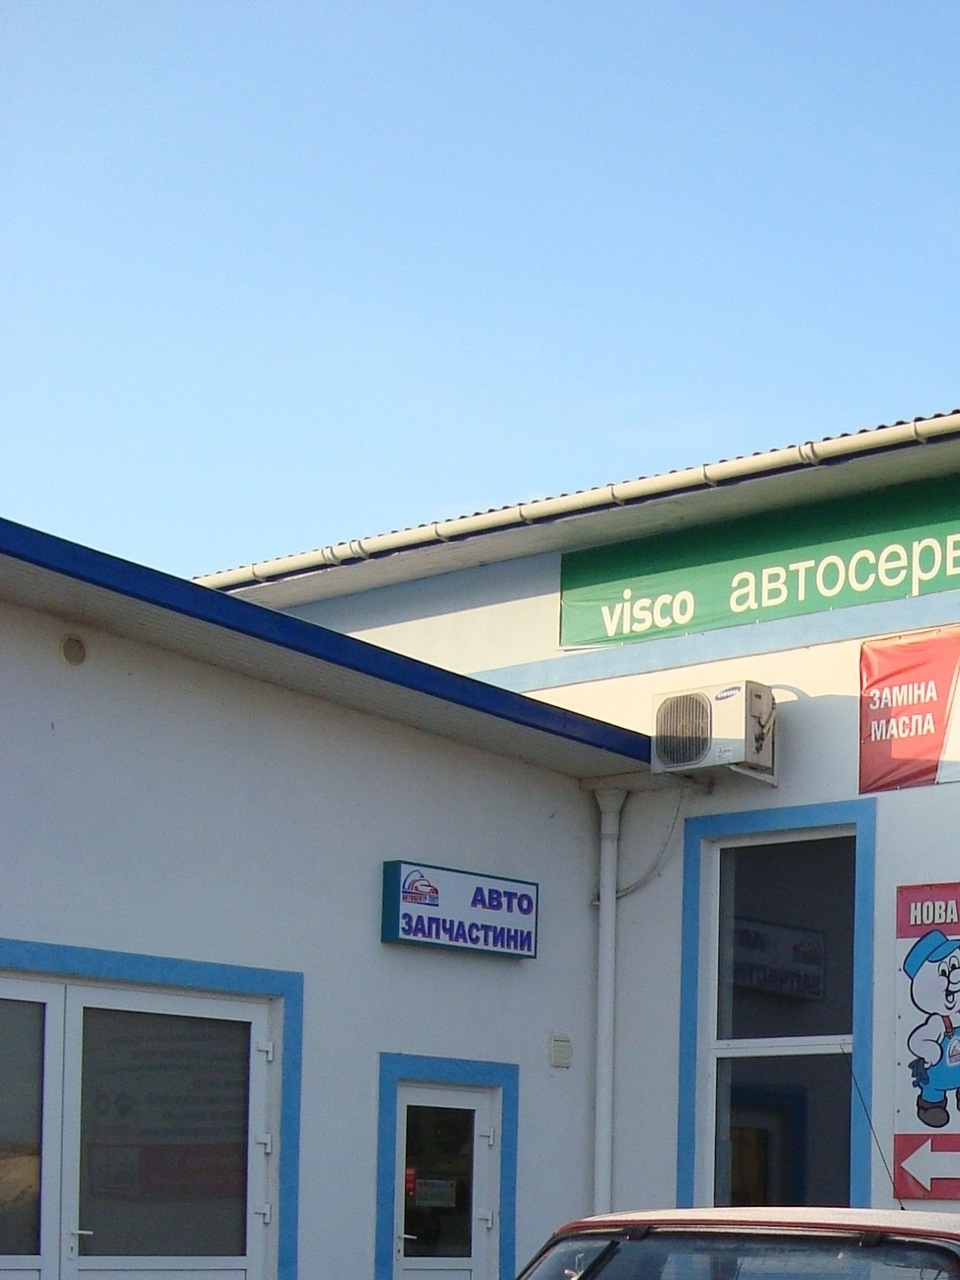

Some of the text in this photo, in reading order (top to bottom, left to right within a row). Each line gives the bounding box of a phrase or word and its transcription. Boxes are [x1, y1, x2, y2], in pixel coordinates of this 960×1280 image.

[601, 589, 695, 637] visco
[869, 680, 938, 710] ЗАМІНА
[870, 713, 936, 742] МАСЛА
[470, 886, 534, 916] АВТО
[910, 901, 958, 926] НОВА
[401, 912, 533, 952] ЗАПЧАСТИНИ
